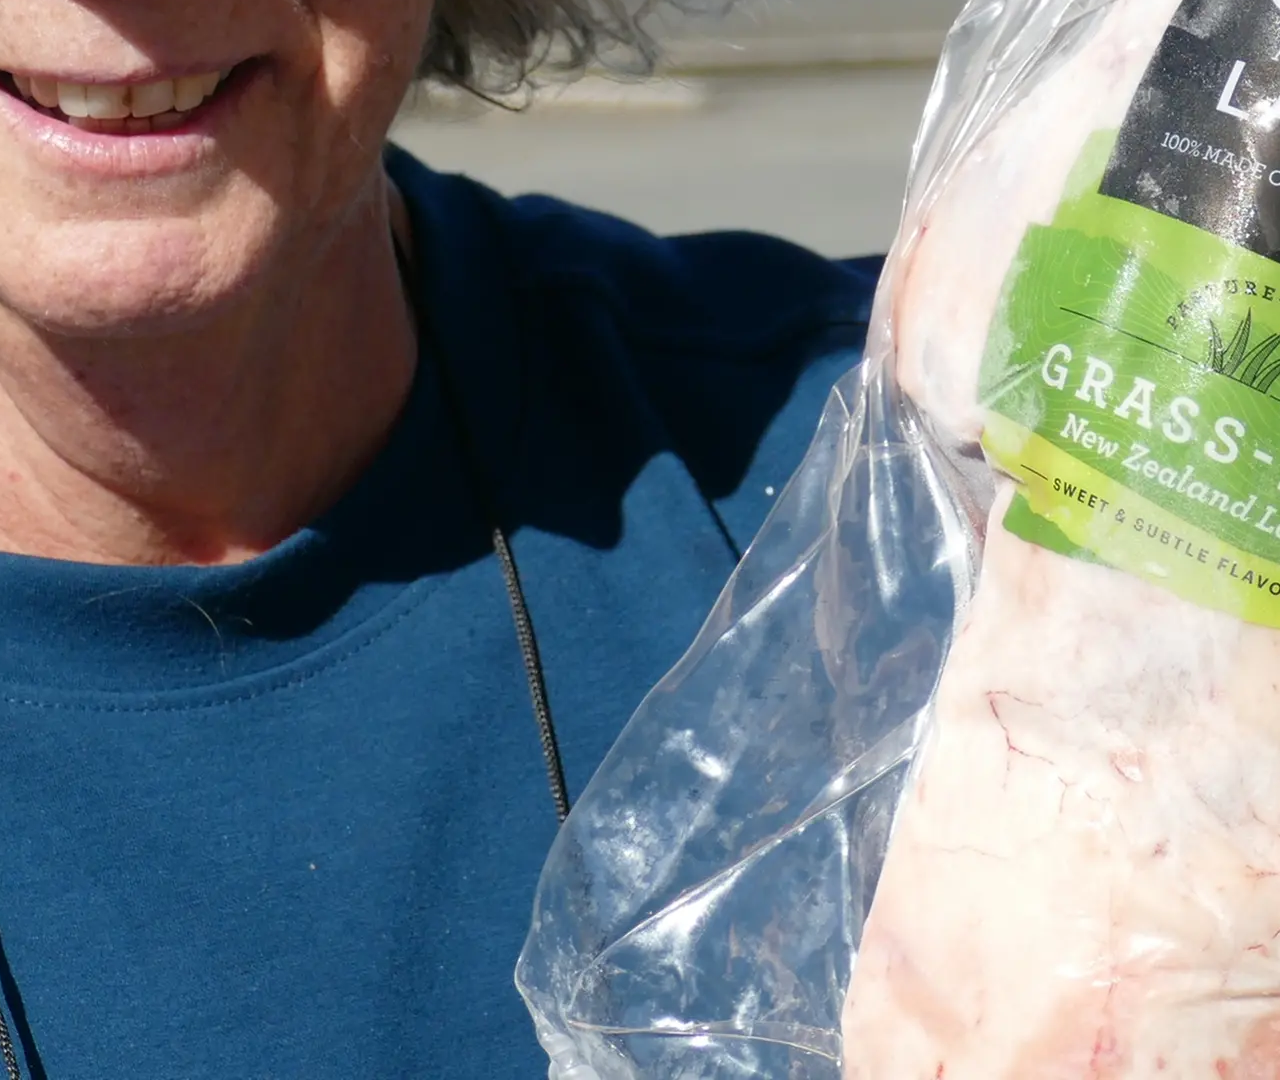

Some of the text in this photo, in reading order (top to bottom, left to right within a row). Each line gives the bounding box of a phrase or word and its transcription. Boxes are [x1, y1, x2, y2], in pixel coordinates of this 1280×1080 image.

[1160, 131, 1201, 158] 100%
[1202, 144, 1268, 181] MADE
[1060, 412, 1121, 459] New
[1121, 443, 1258, 523] Zealand
[1052, 477, 1110, 514] SWEET
[1114, 507, 1129, 524] &
[1132, 516, 1210, 564] SUBTLE
